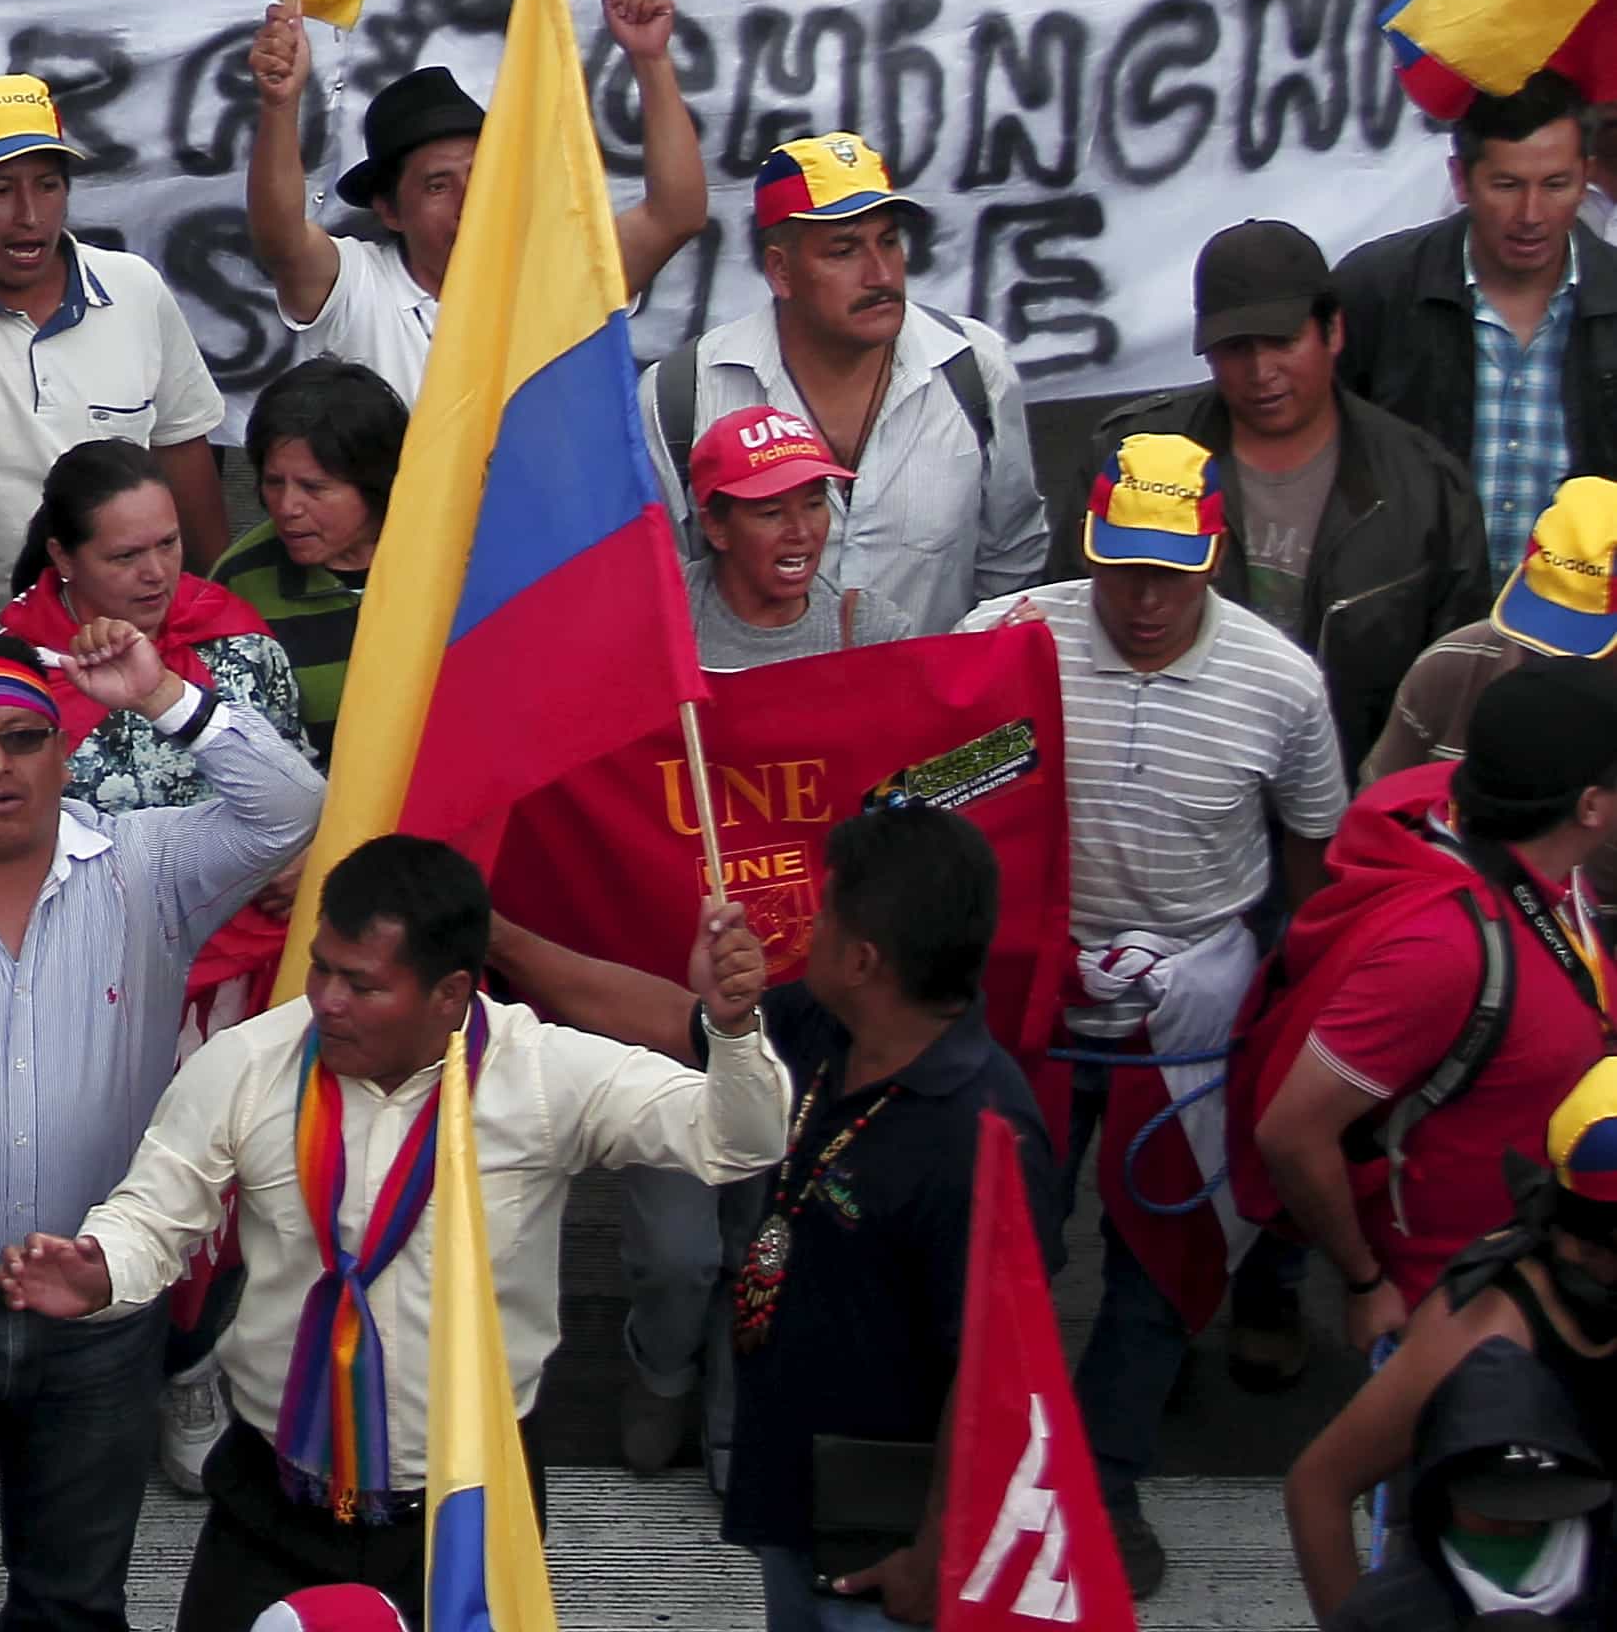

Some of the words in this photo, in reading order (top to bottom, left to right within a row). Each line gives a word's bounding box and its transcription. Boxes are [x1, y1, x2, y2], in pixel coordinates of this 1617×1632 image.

[738, 415, 814, 449] UNE
[654, 759, 832, 836] UNE
[702, 850, 805, 888] UNE
[1513, 884, 1538, 915] EOS
